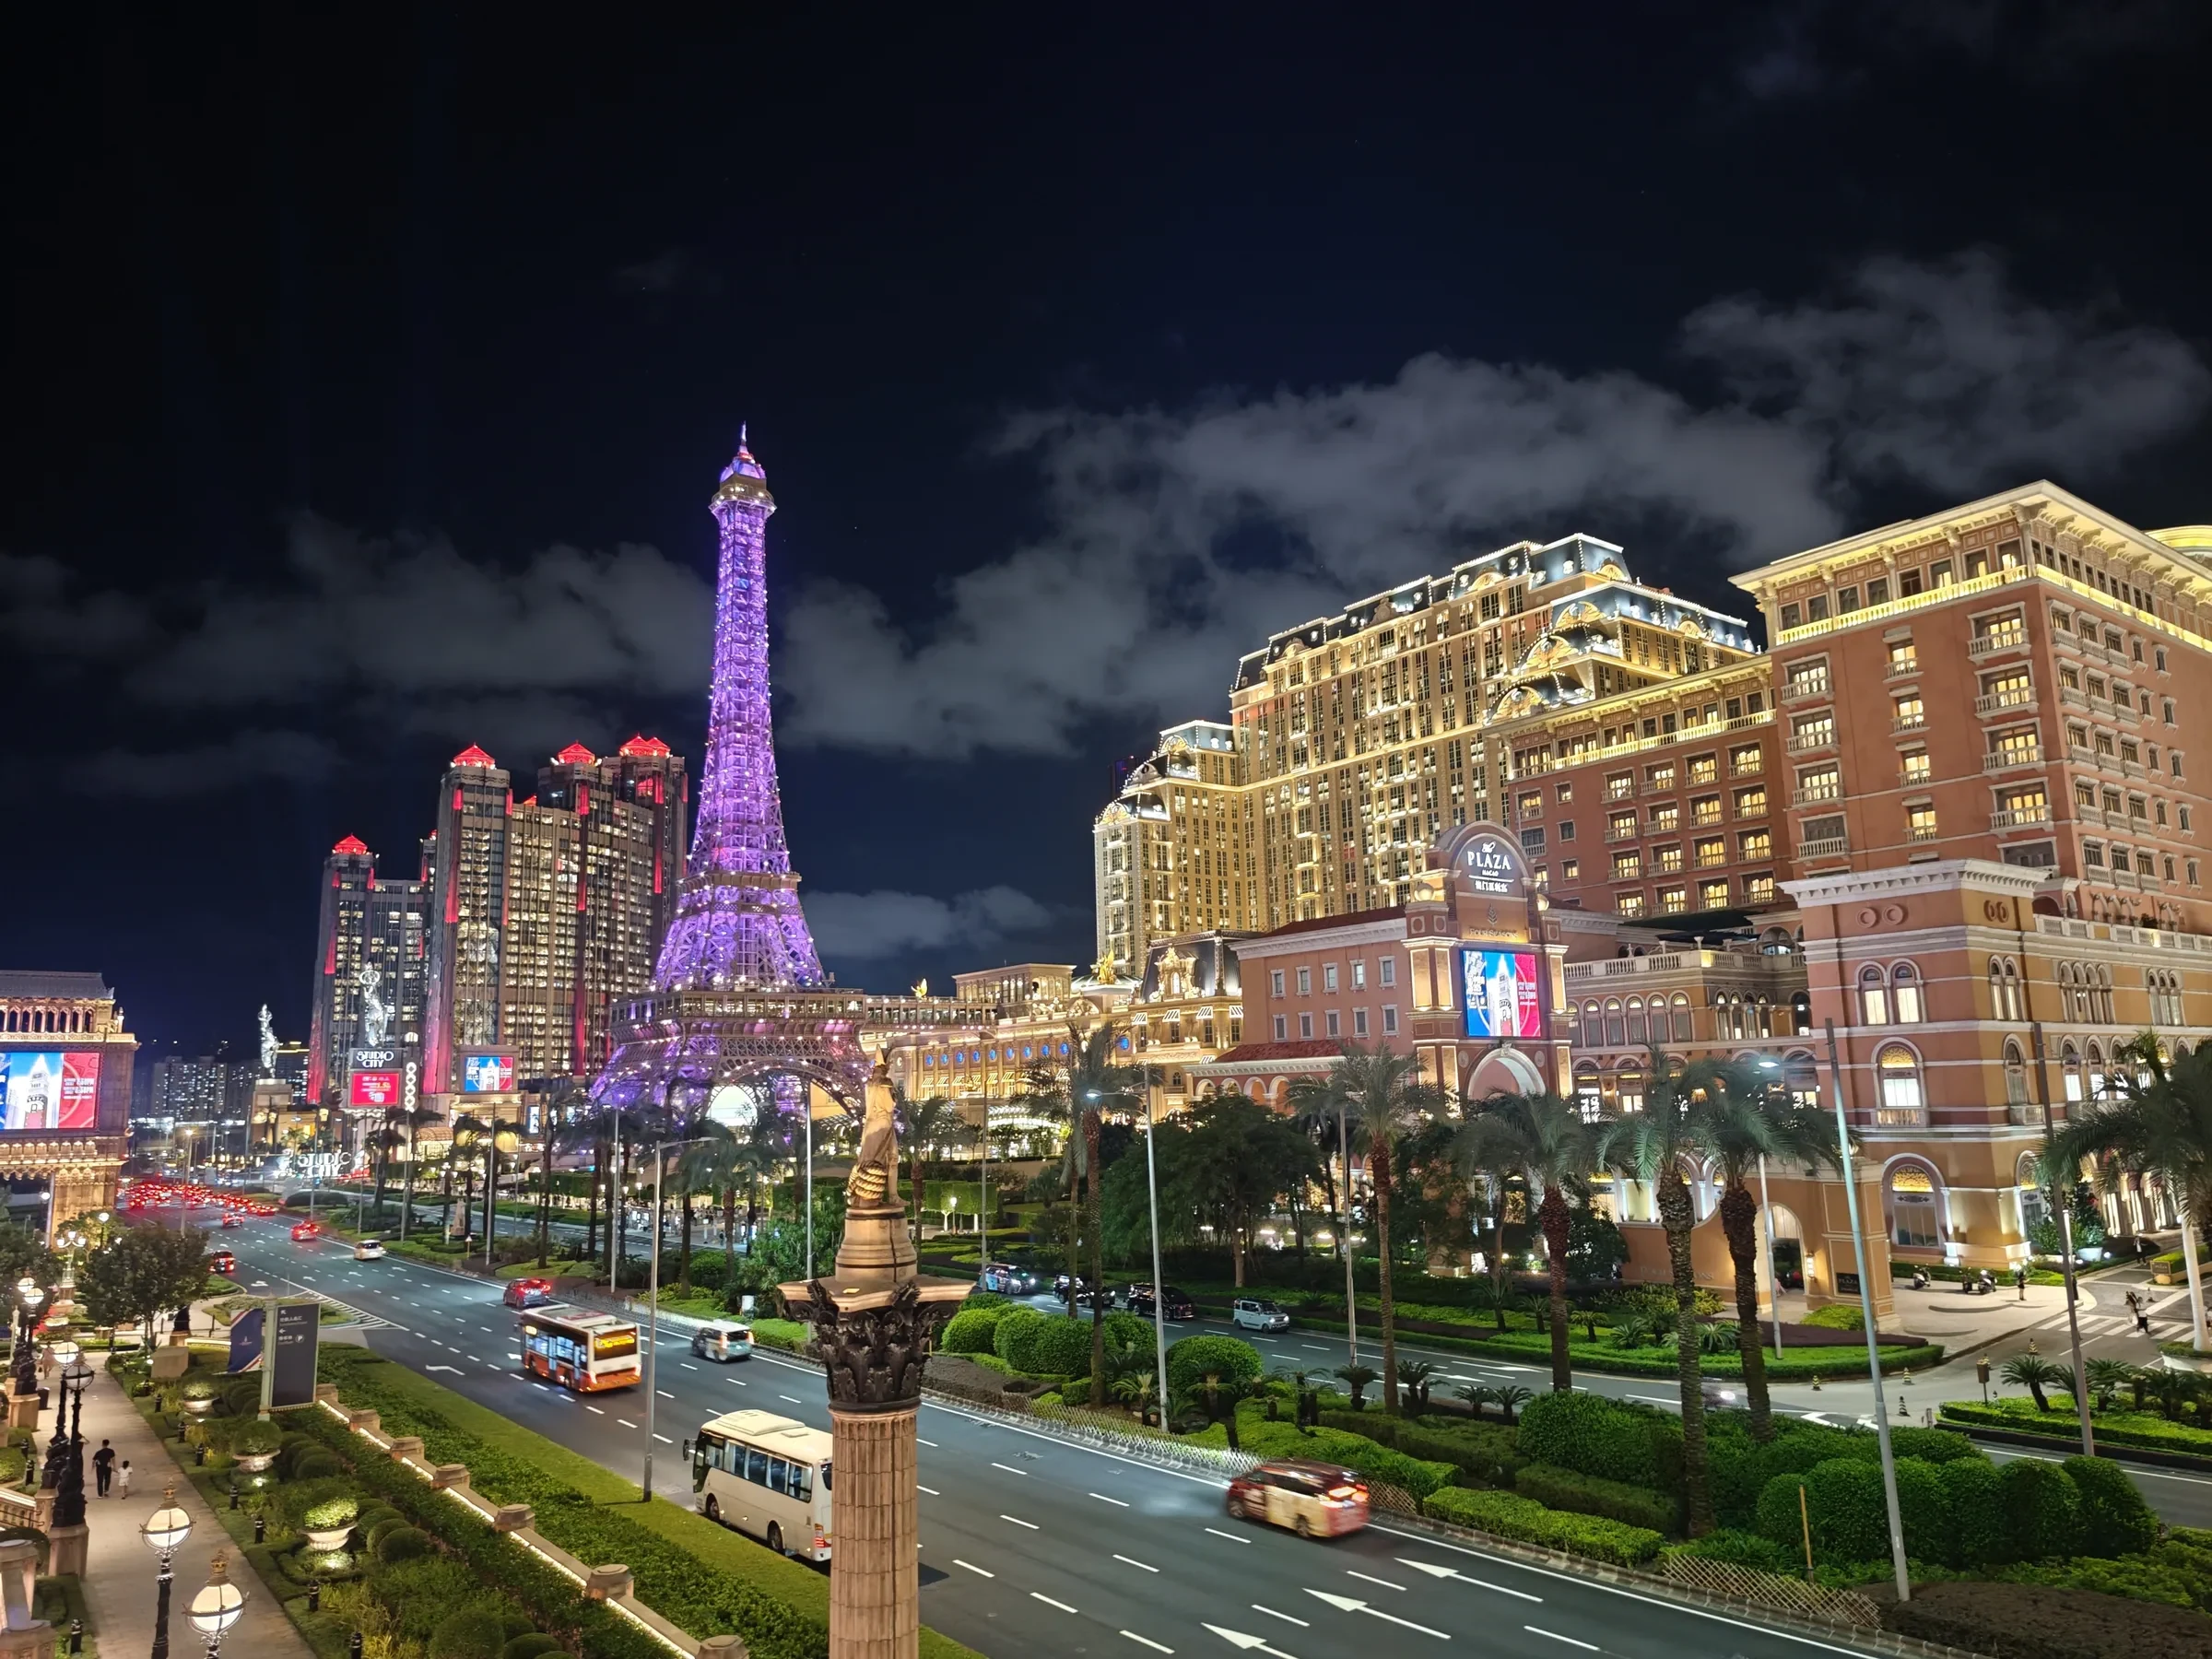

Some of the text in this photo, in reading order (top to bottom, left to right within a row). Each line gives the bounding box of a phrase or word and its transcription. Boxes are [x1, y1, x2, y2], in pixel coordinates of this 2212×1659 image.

[1467, 851, 1512, 870] PLAZA
[1469, 928, 1519, 937] FOUR SEASONS
[356, 1051, 394, 1061] STUDIO
[298, 1152, 351, 1167] STUDIO
[307, 1165, 340, 1177] CITY
